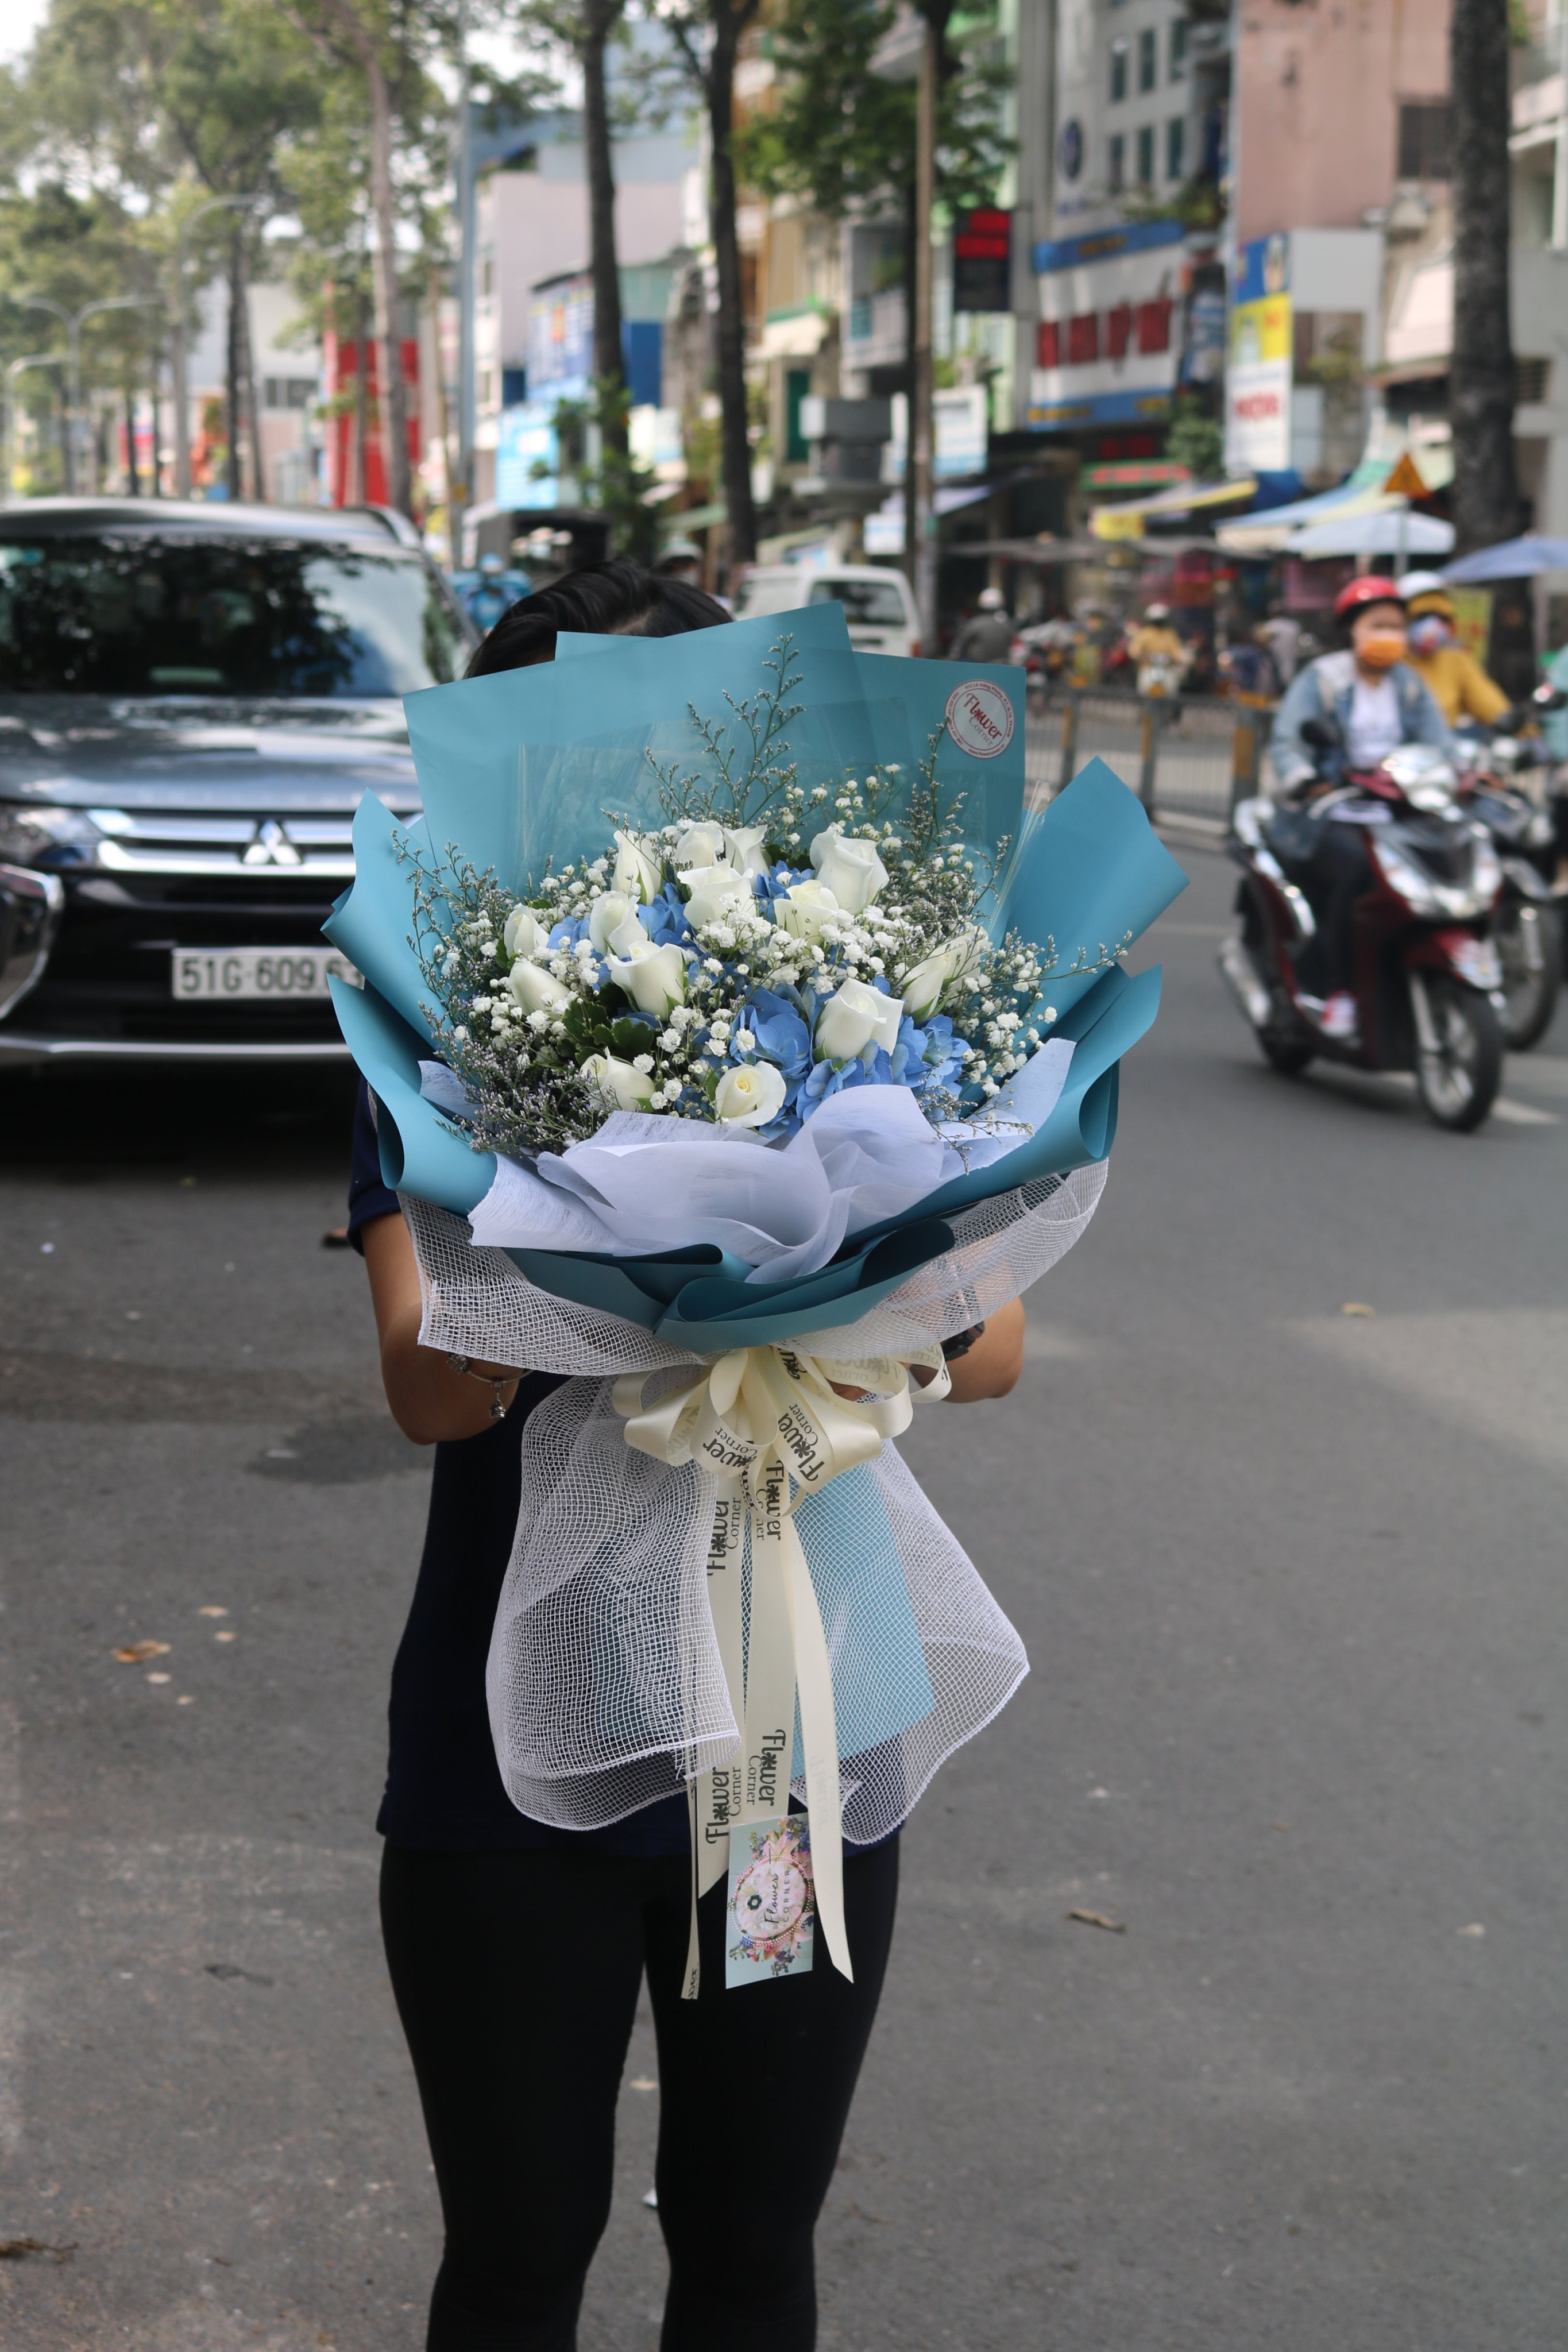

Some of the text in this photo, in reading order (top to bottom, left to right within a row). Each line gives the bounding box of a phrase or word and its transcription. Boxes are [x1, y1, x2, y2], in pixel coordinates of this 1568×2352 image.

[964, 693, 1002, 739] Flower
[970, 717, 994, 746] Corner
[789, 1403, 818, 1446] Corner
[725, 1497, 741, 1550] Corner
[727, 1766, 741, 1816] Corner
[747, 1755, 763, 1806] Corner
[758, 1729, 786, 1807] Flower
[705, 1766, 729, 1844] Flower
[763, 1873, 779, 1924] Flower
